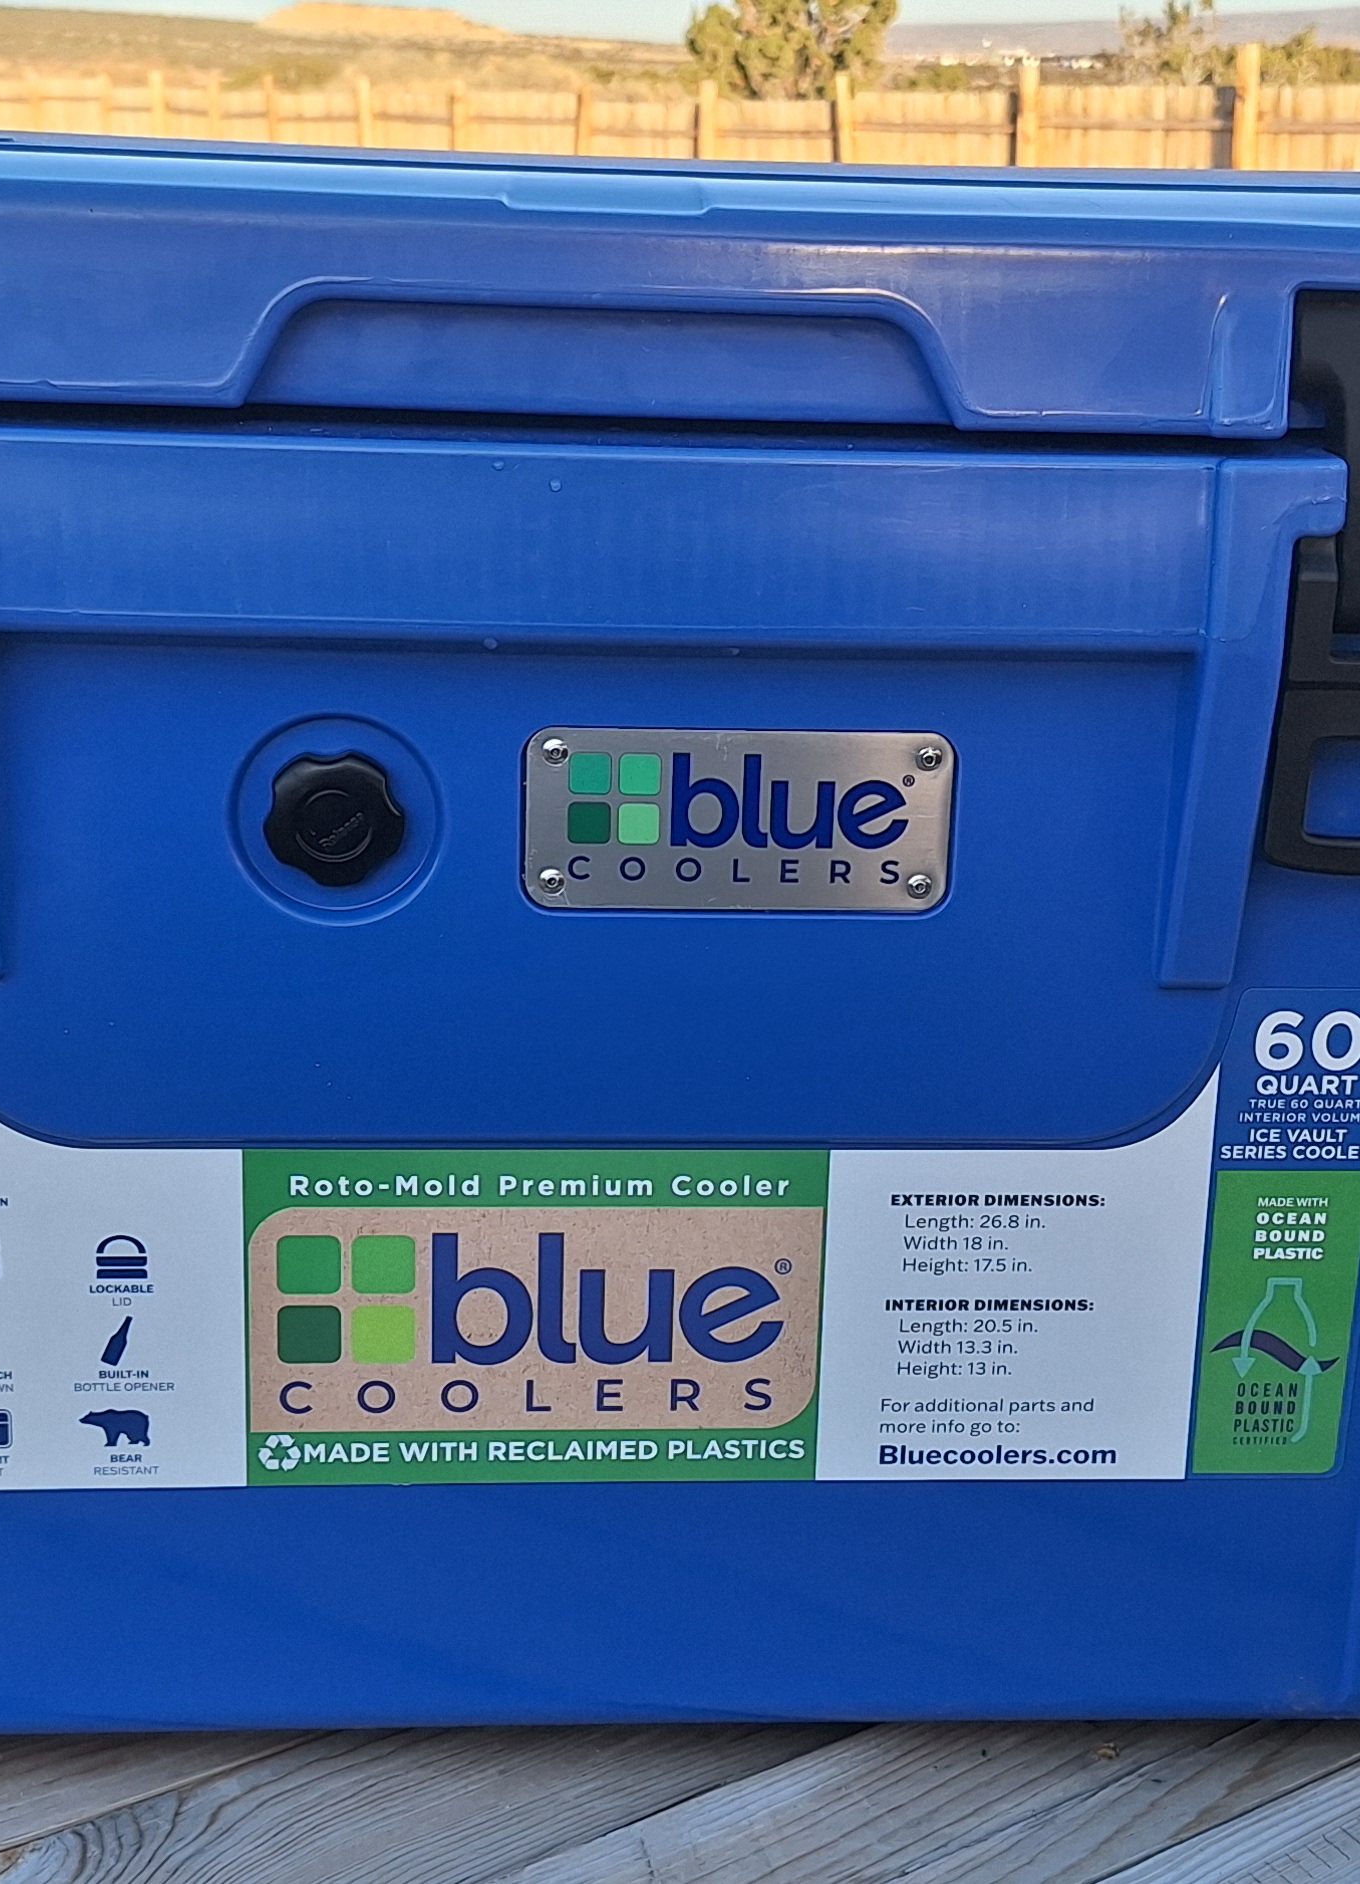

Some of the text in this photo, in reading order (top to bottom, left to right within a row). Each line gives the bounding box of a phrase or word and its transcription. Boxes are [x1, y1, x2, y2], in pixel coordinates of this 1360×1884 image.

[567, 855, 900, 885] COOLERS
[1256, 1075, 1359, 1095] QUART
[1249, 1099, 1286, 1109] TRUE
[1290, 1099, 1309, 1109] 60
[1239, 1112, 1307, 1123] INTERIOR
[1249, 1128, 1348, 1143] ICE VAULT
[1220, 1145, 1287, 1159] SERIES
[290, 1174, 789, 1196] Roto-Mold Premium Cooler
[890, 1194, 1105, 1207] EXTERIOR DIMENSIONS:
[1257, 1197, 1329, 1207] MADE WITH
[905, 1214, 1046, 1232] Length: 26.8 in.
[1256, 1212, 1327, 1225] OCEAN
[903, 1235, 1009, 1251] Width 18 in.
[1254, 1229, 1325, 1242] BOUND
[1253, 1247, 1324, 1260] PLASTIC
[902, 1257, 1032, 1276] Height: 17.5 in.
[89, 1284, 154, 1294] LOCKABLE
[112, 1296, 132, 1307] LID
[885, 1299, 1094, 1312] INTERIOR DIMENSIONS:
[899, 1318, 1038, 1337] Length: 20.5 in.
[897, 1340, 1018, 1355] Width 13.3 in.
[98, 1370, 149, 1379] BUILT-IN
[897, 1361, 1012, 1380] Height: 13 in.
[73, 1382, 175, 1392] BOTTLE OPENER
[1237, 1382, 1298, 1398] OCEAN
[279, 1377, 772, 1415] COOLERS
[881, 1398, 1094, 1416] For additional parts and
[1235, 1400, 1296, 1415] BOUND
[879, 1419, 1020, 1437] more info go to:
[1233, 1418, 1294, 1433] PLASTIC
[110, 1453, 142, 1463] BEAR
[304, 1439, 805, 1463] MADE WITH RECLAIMED PLASTICS
[879, 1444, 1117, 1465] Bluecoolers.com
[93, 1465, 160, 1476] RESISTANT
